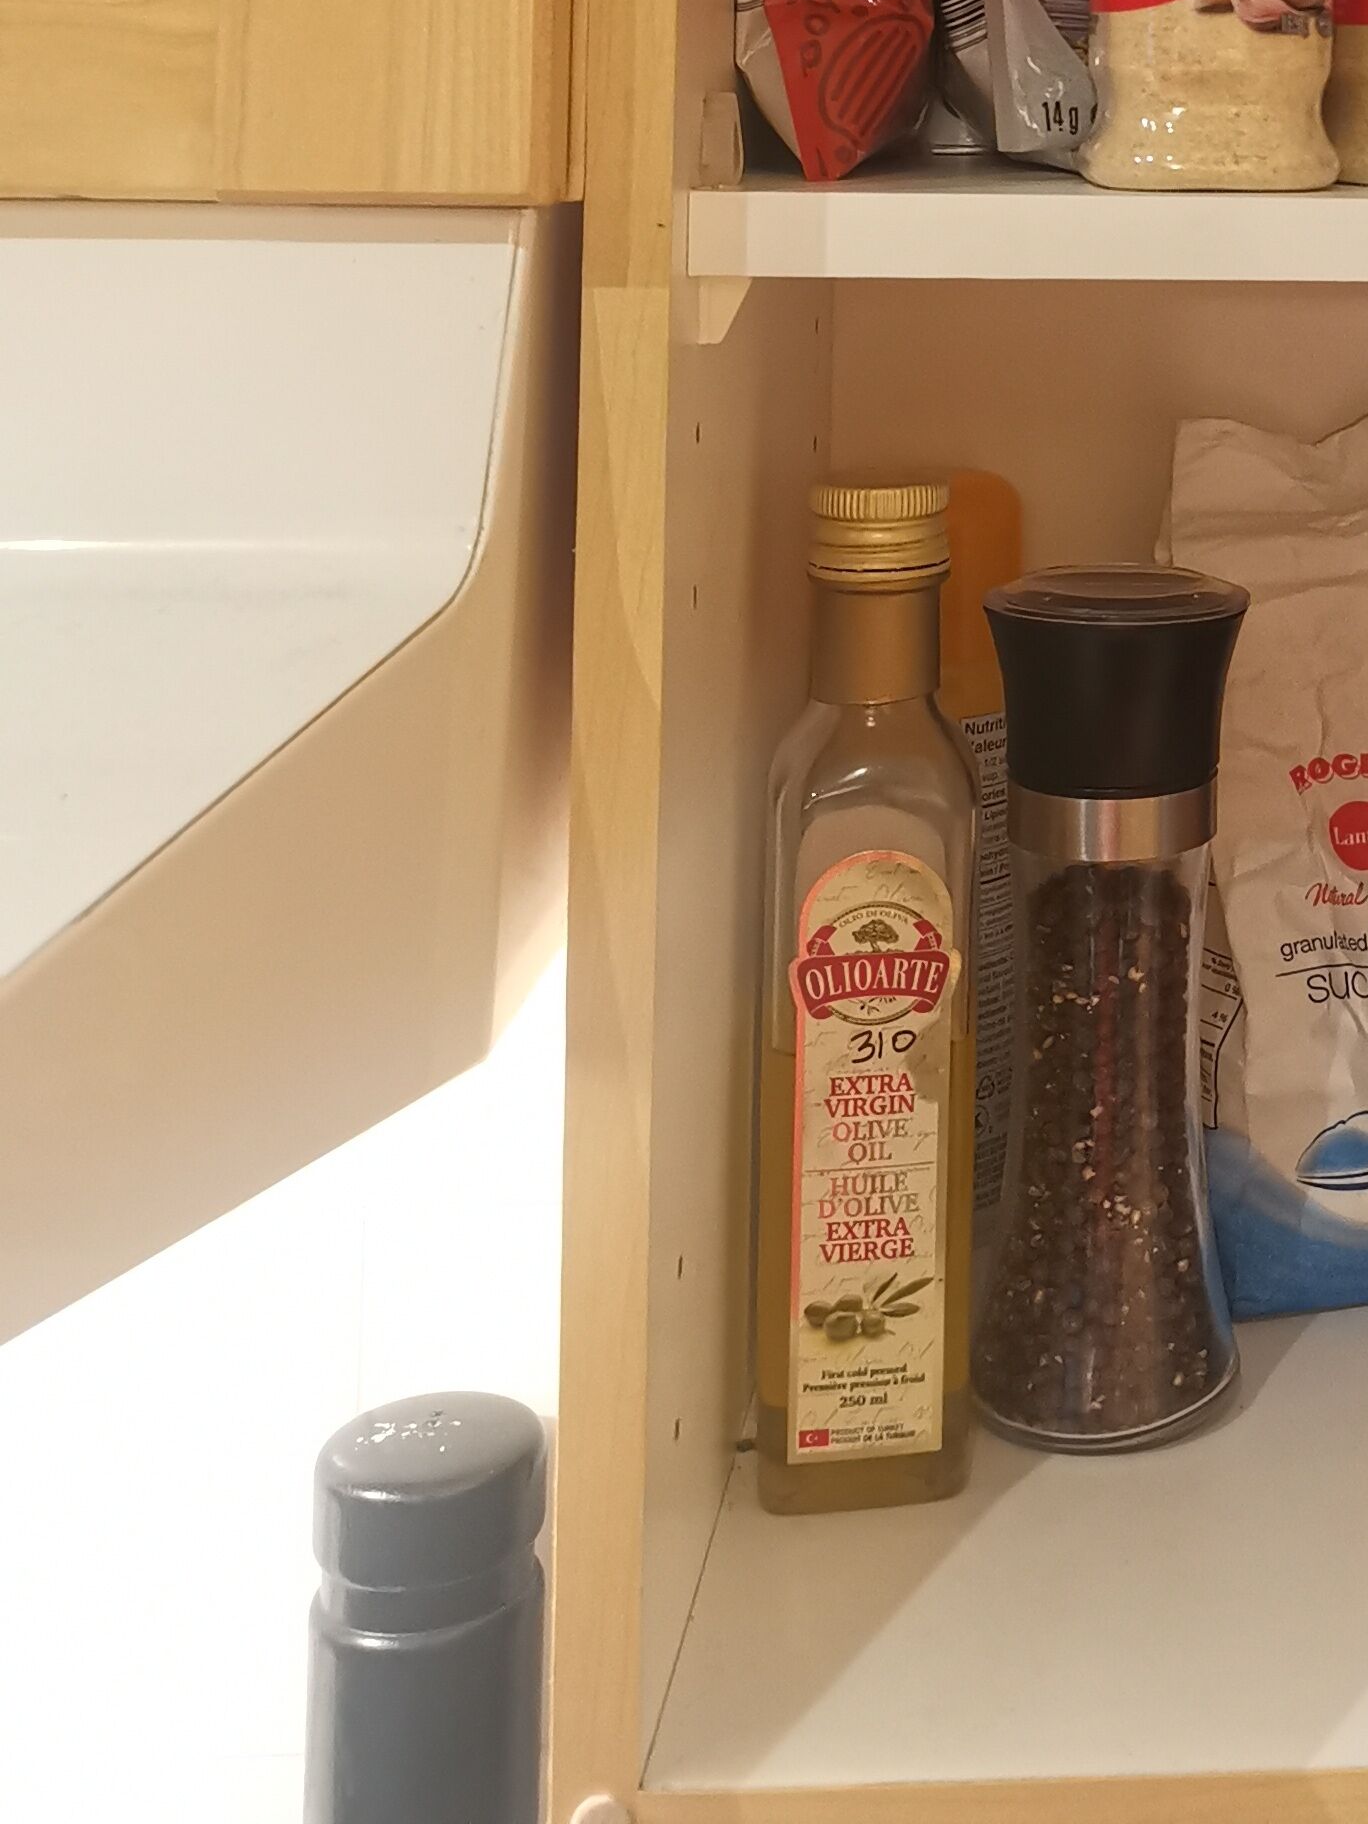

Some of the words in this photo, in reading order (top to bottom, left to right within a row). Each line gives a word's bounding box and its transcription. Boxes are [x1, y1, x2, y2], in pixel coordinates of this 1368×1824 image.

[971, 739, 1006, 753] aleur
[805, 958, 944, 1000] OLIOARTE
[850, 1029, 917, 1064] 310
[829, 1073, 914, 1097] EXTRA
[824, 1094, 915, 1118] VIRGIN
[832, 1118, 910, 1142] OLIVE
[848, 1142, 893, 1165] OIL
[830, 1172, 908, 1197] HUILE
[826, 1217, 910, 1241] EXTRA
[819, 1238, 915, 1263] VIERGE
[840, 1395, 866, 1408] 250
